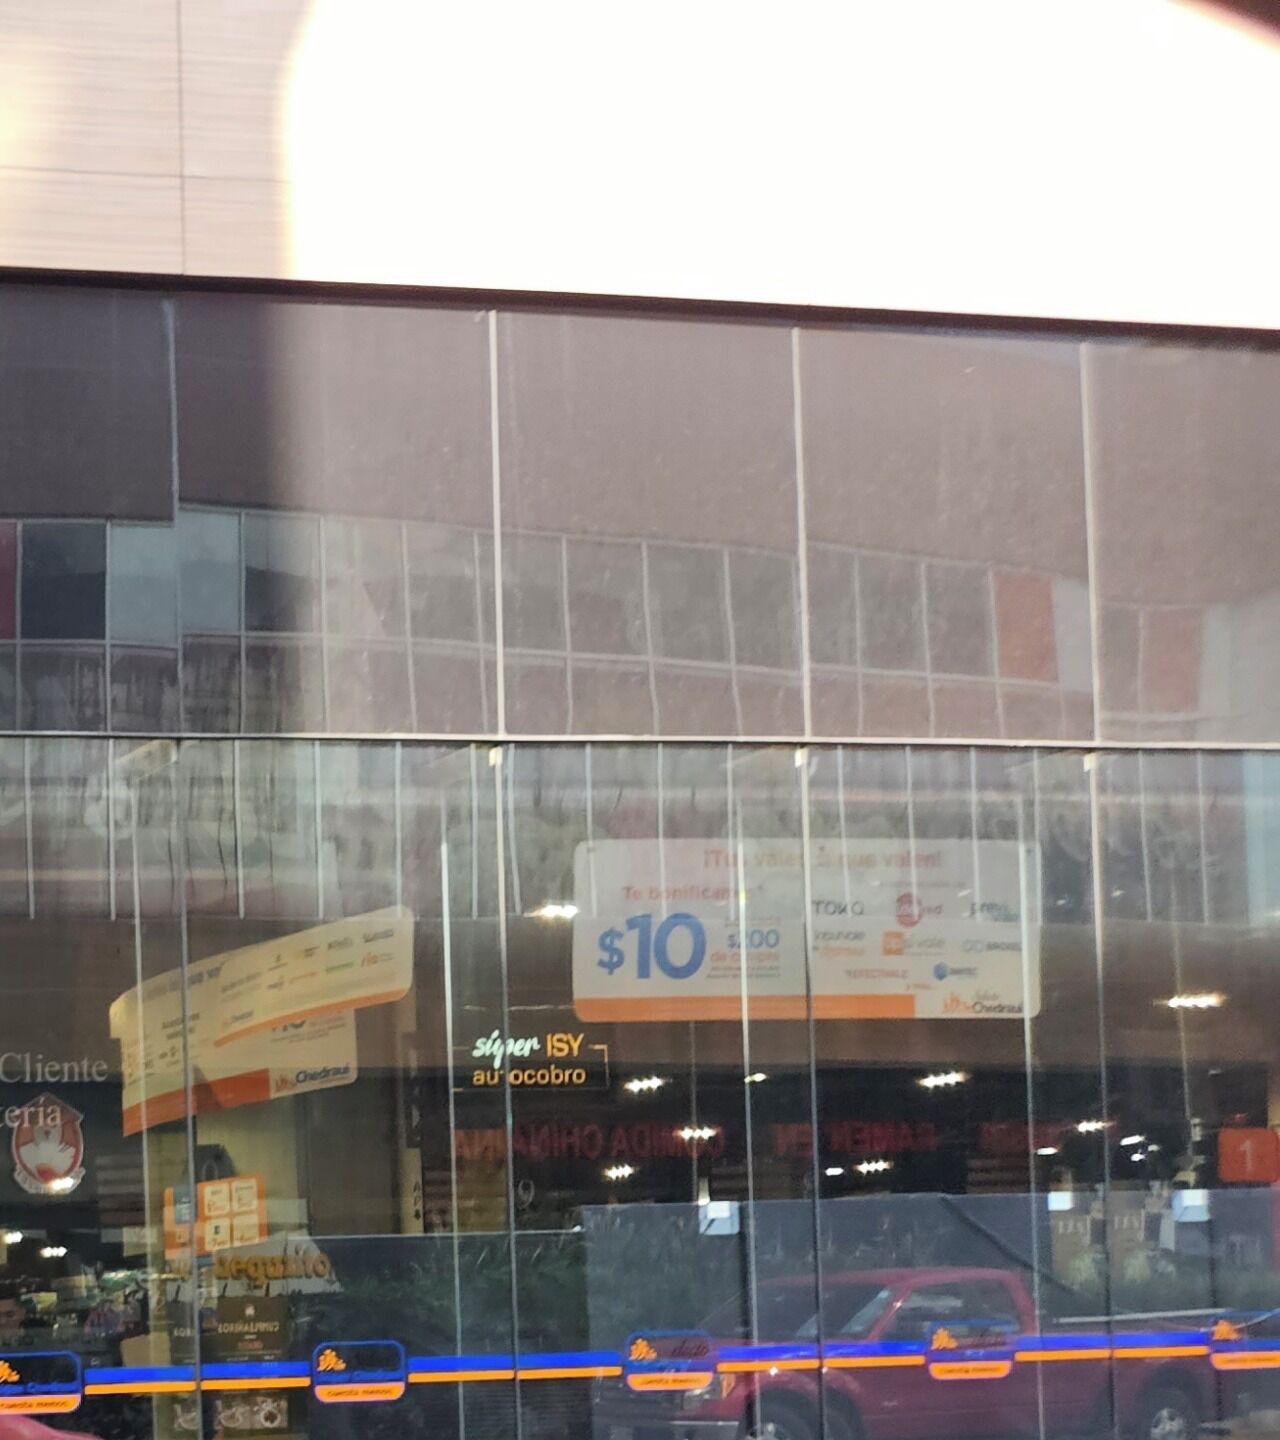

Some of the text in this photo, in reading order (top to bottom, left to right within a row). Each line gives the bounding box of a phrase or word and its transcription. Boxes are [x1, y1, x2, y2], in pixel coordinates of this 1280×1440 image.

[597, 912, 707, 980] $10
[727, 929, 780, 950] $00
[472, 1064, 587, 1086] auocobro
